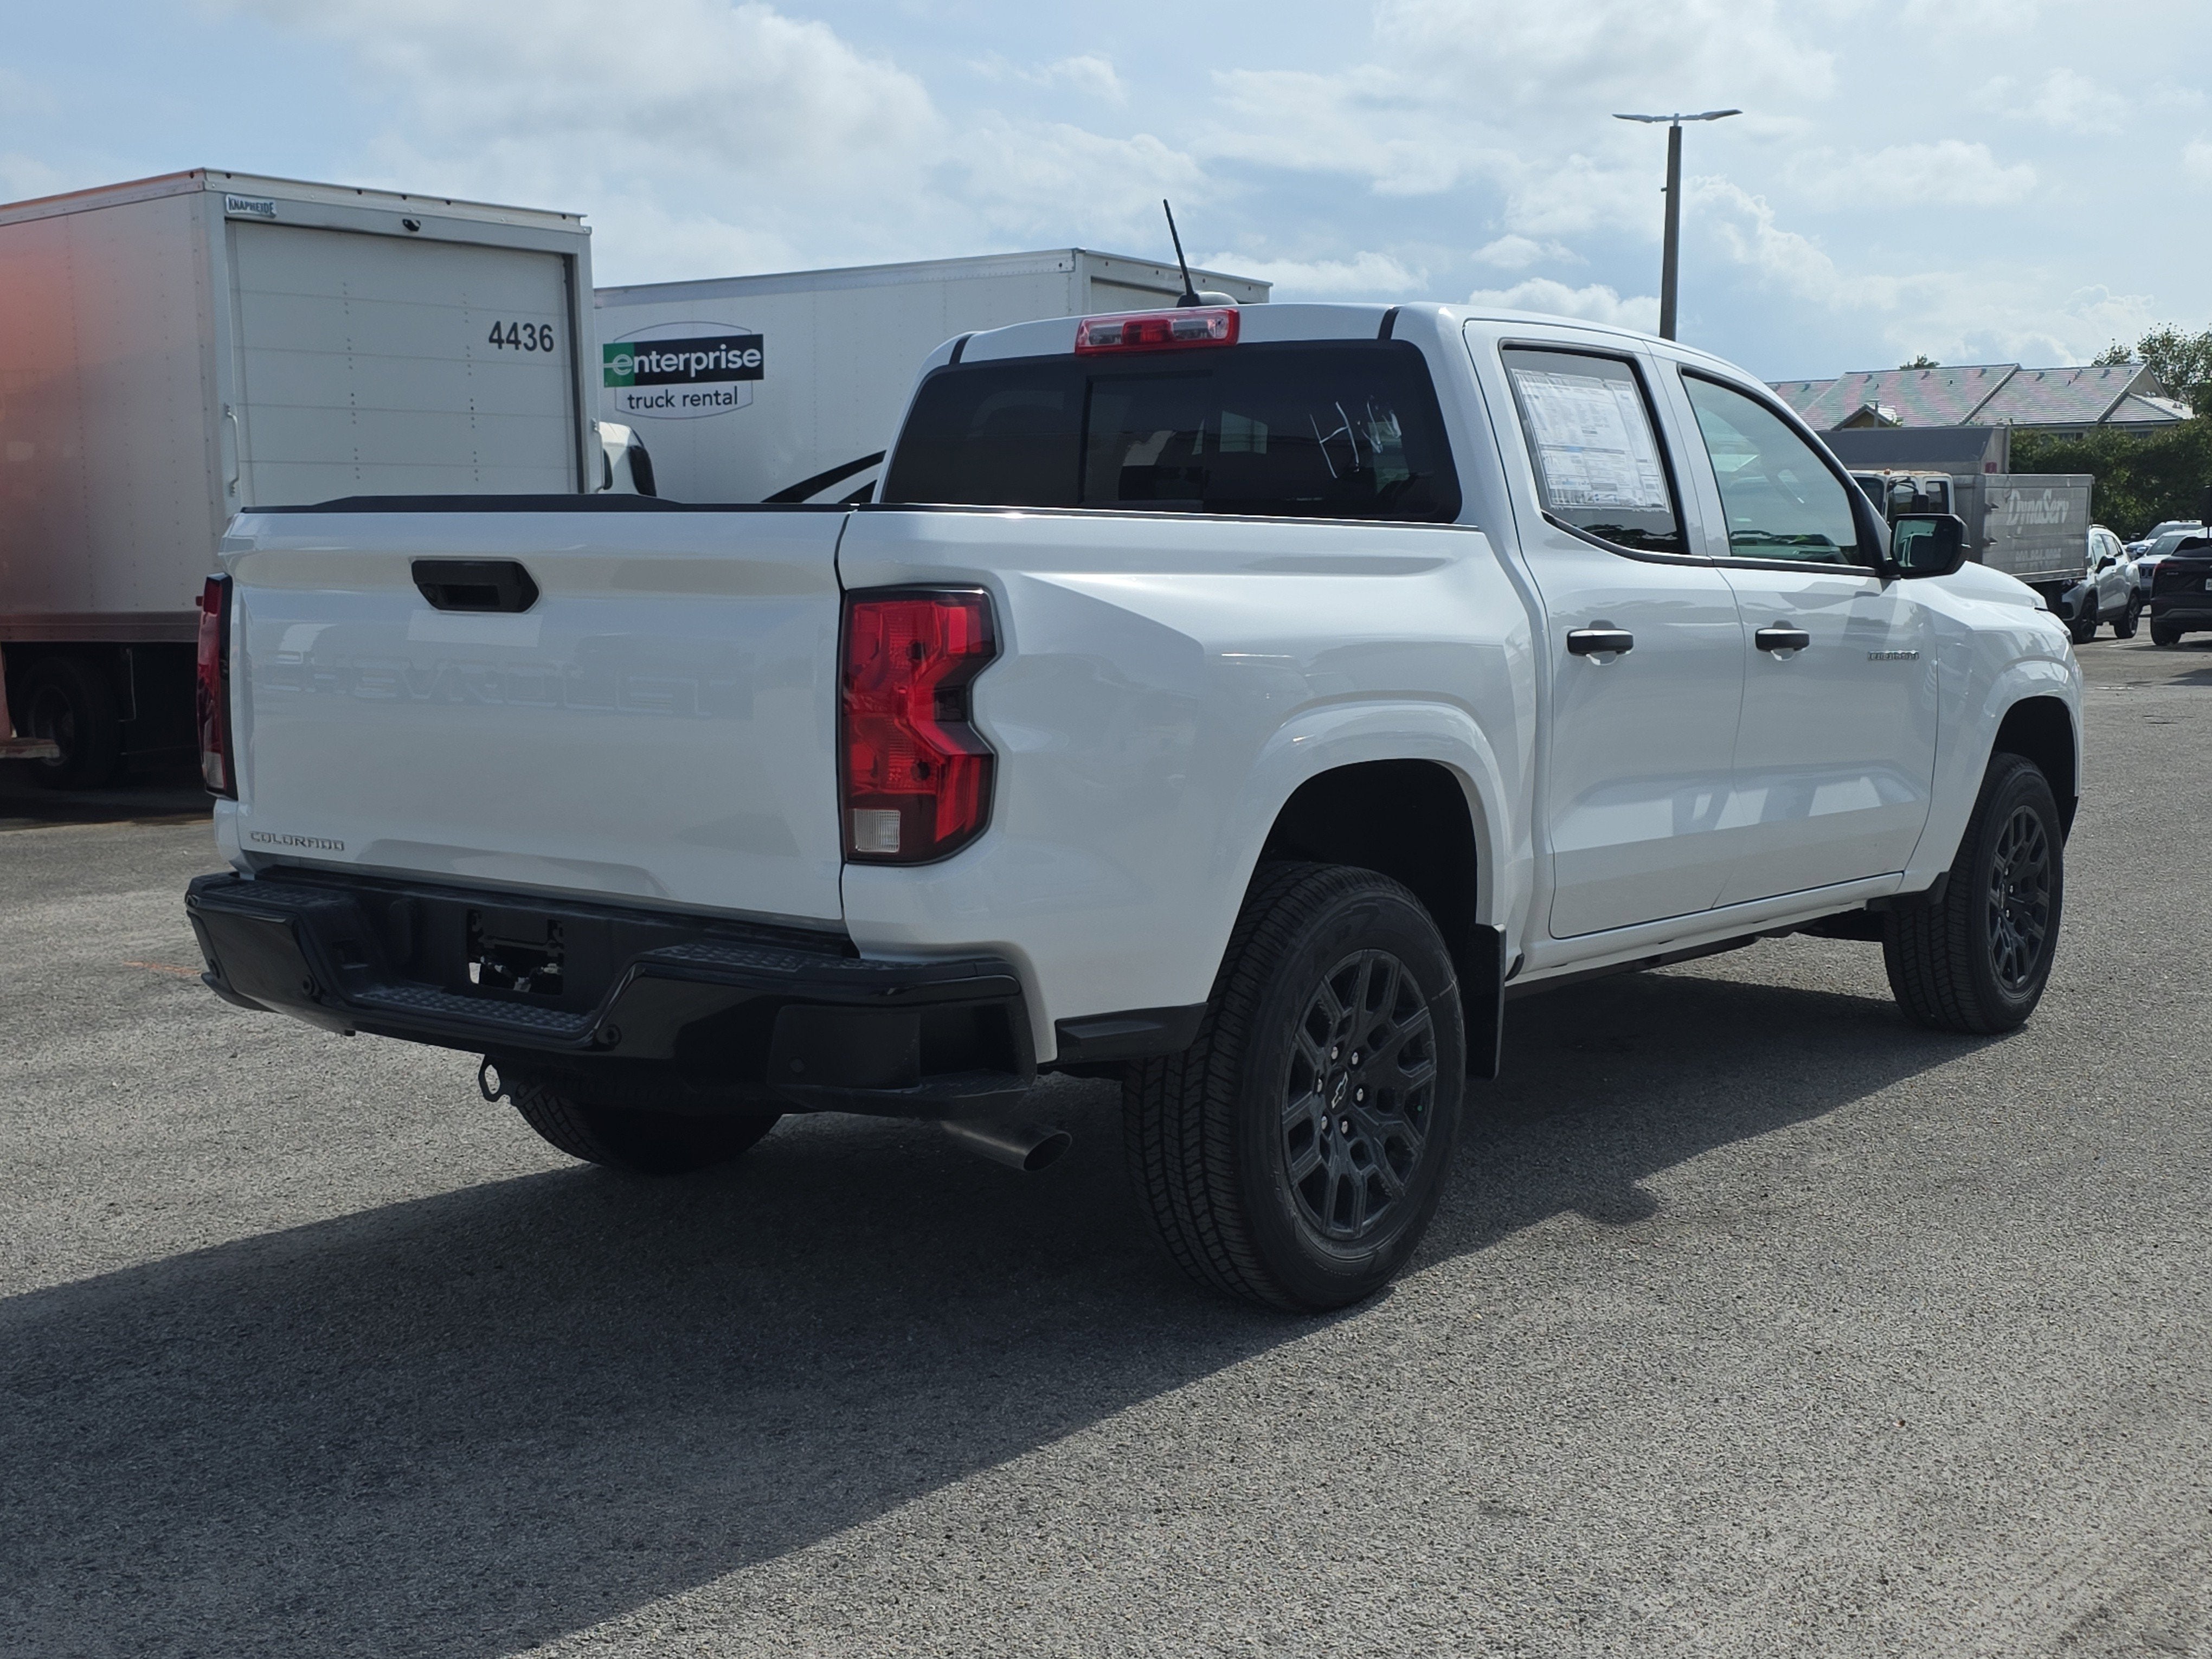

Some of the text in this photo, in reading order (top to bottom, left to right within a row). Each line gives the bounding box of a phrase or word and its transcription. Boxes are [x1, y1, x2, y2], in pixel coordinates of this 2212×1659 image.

[228, 197, 274, 215] KNAPHEIDE
[488, 320, 554, 352] 4436
[604, 344, 761, 378] enterprise
[627, 385, 738, 409] truck rental
[249, 831, 345, 851] COLORADO
